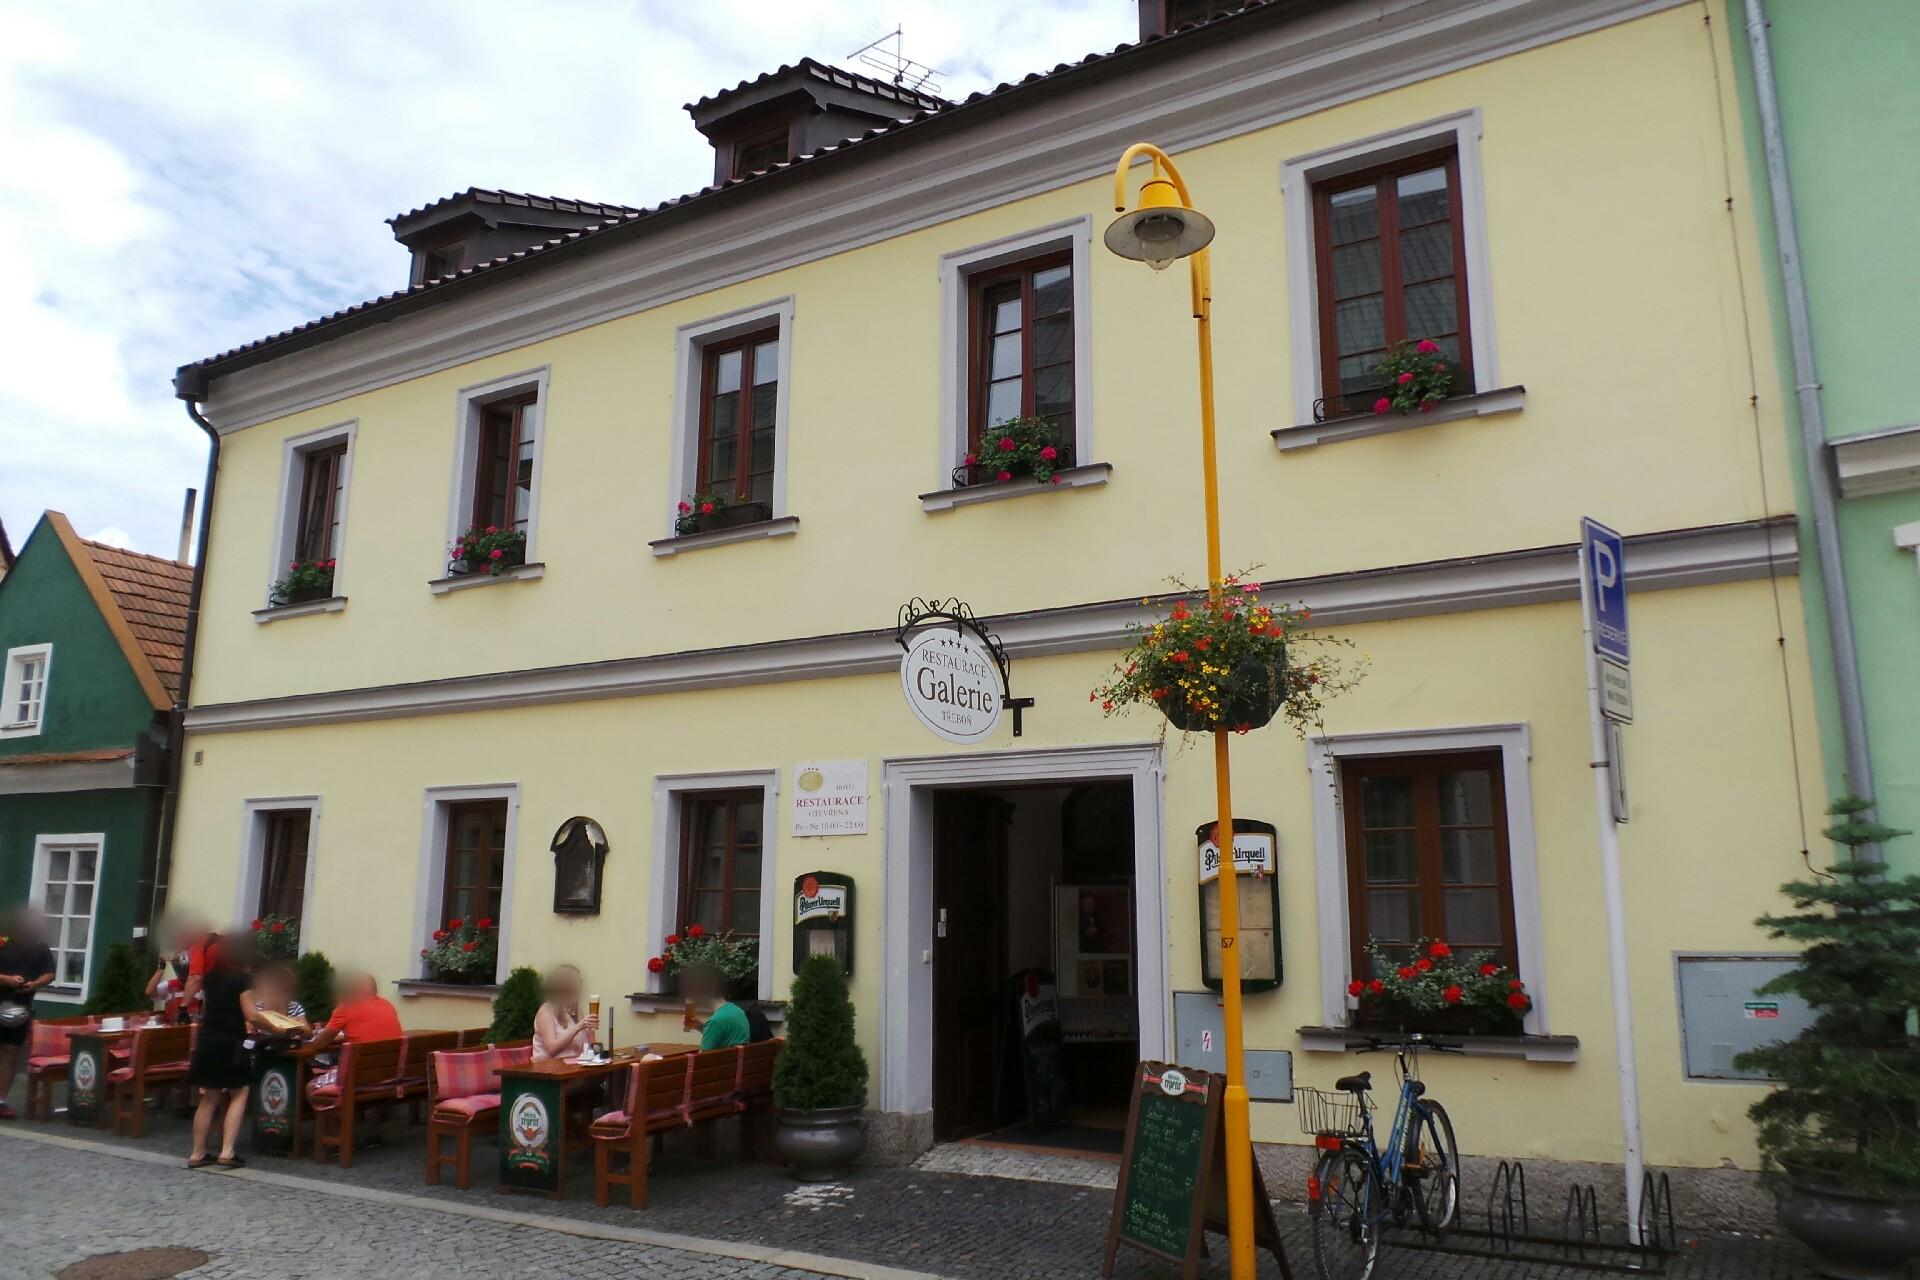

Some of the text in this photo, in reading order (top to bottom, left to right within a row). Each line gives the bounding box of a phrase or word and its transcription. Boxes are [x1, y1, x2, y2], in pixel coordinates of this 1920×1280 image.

[1593, 539, 1617, 612] P
[922, 649, 987, 678] RESTAURACE
[917, 666, 993, 714] Galerie
[796, 795, 864, 808] RESTAURACE
[1234, 847, 1265, 863] Urquell
